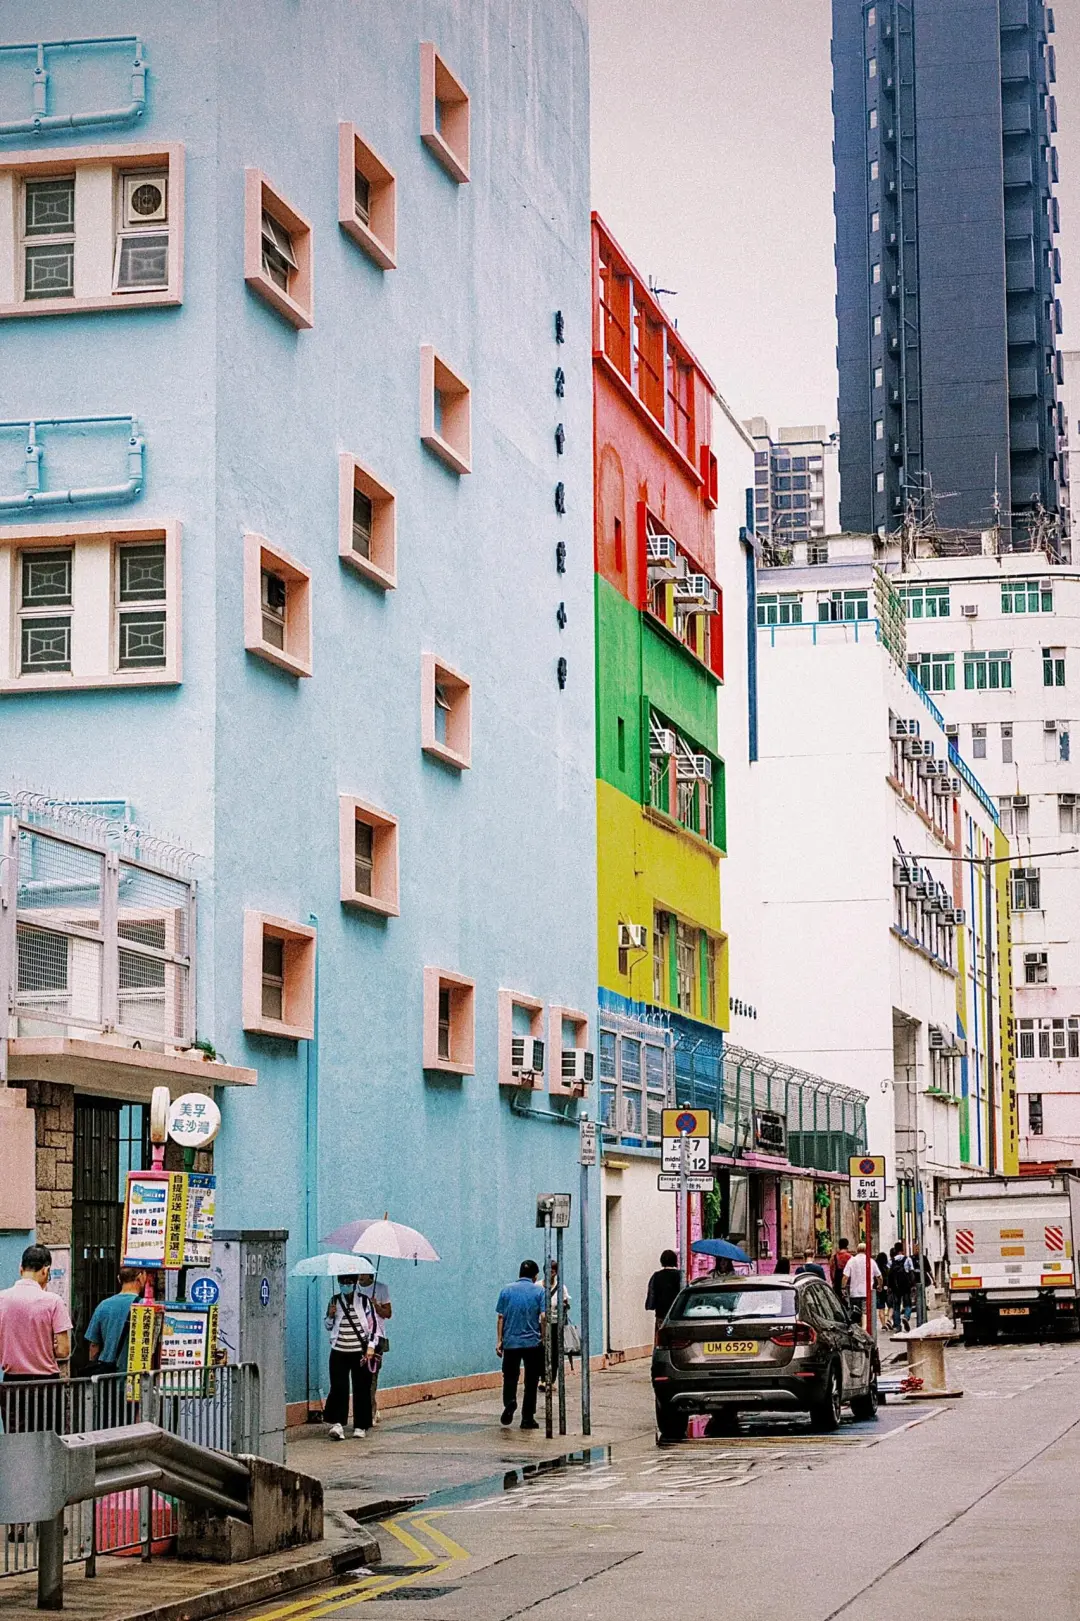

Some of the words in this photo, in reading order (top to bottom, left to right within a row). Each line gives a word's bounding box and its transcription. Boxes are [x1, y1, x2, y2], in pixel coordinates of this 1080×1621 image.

[180, 1102, 206, 1118] 美孚
[172, 1118, 210, 1134] 長沙灣
[692, 1140, 700, 1151] 7
[692, 1158, 707, 1170] 12
[859, 1179, 876, 1187] End
[171, 1174, 183, 1212] 自提派送
[857, 1188, 879, 1198] 終止
[169, 1213, 182, 1251] 集運首選
[142, 1307, 152, 1346] 大陸寄香港
[707, 1343, 722, 1352] UM
[725, 1342, 754, 1352] 6529
